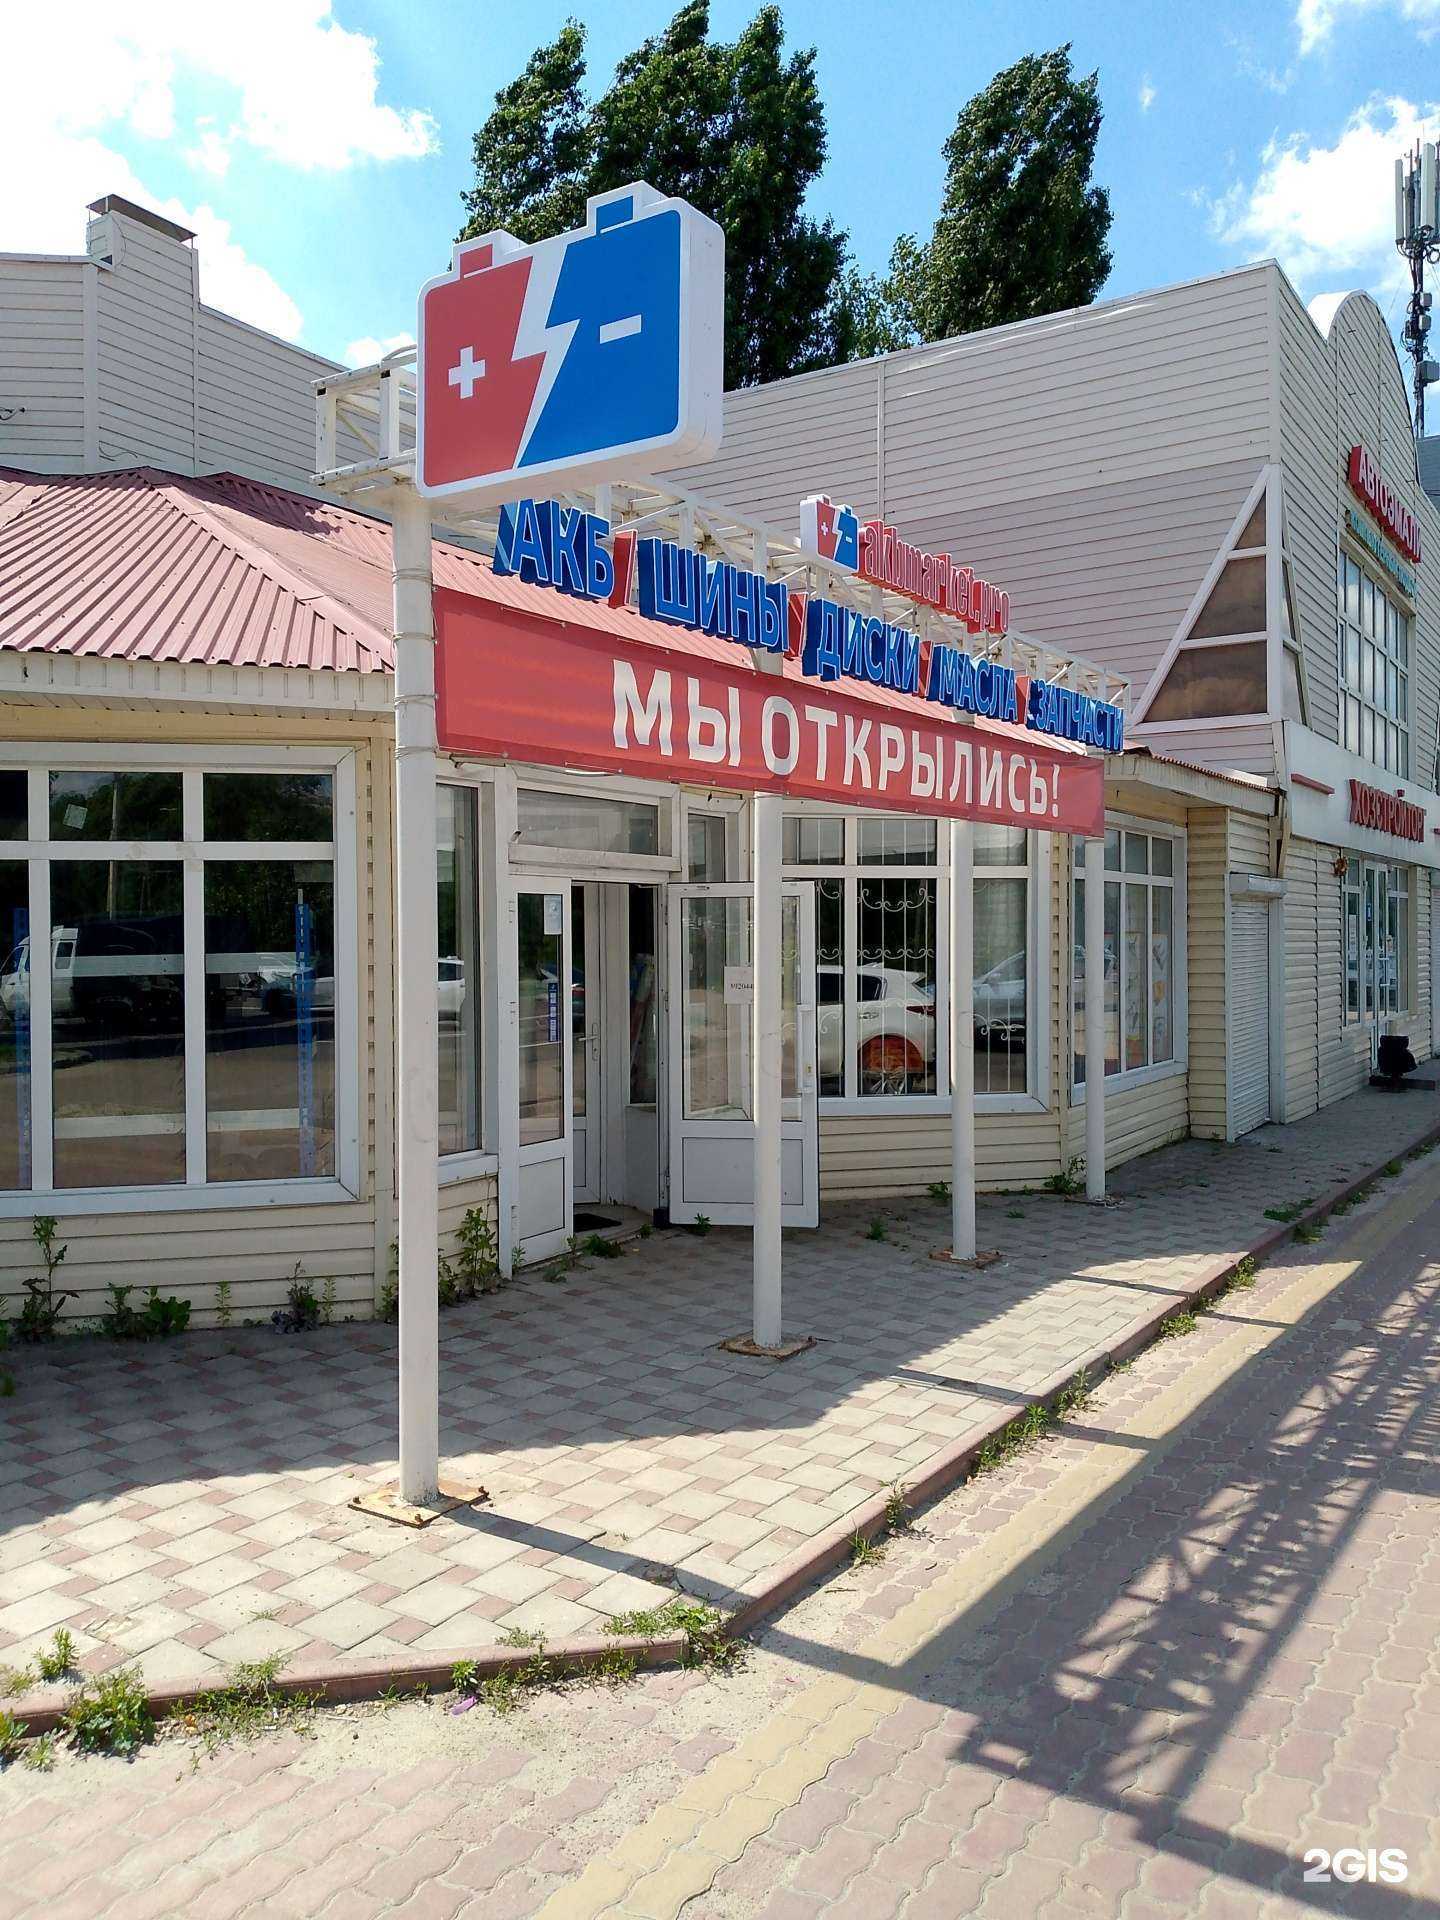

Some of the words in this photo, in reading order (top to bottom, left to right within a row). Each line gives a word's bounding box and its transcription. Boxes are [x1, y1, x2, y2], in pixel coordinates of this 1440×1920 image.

[507, 498, 615, 599] АКБ
[653, 537, 790, 652] ШИНЫ
[817, 599, 920, 693] ДИСКИ
[939, 645, 1018, 722] МАСЛА
[1034, 679, 1124, 753] ЗАПЧАСТИ
[863, 520, 1011, 634] akbmarket.pro
[612, 658, 741, 767] МЫ
[761, 695, 1061, 818] ОТКРЫЛИСЬ!
